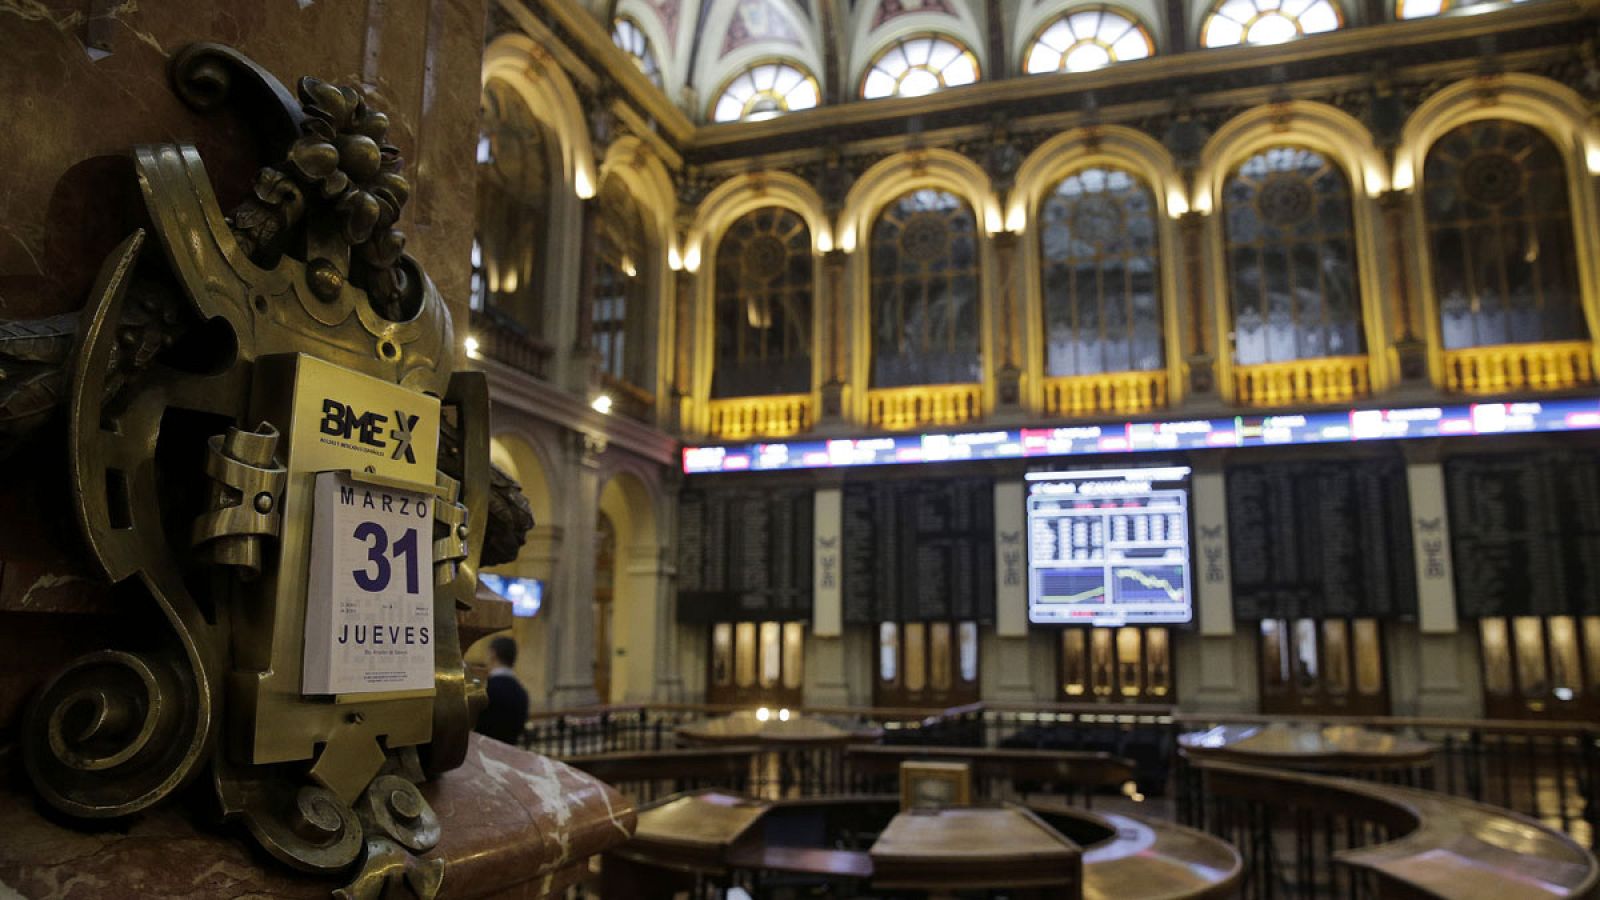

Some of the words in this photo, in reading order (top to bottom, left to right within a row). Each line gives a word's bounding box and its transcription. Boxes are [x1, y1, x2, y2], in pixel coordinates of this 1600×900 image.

[340, 486, 427, 518] MARZO
[352, 520, 418, 593] 31
[338, 625, 429, 645] JUEVES
